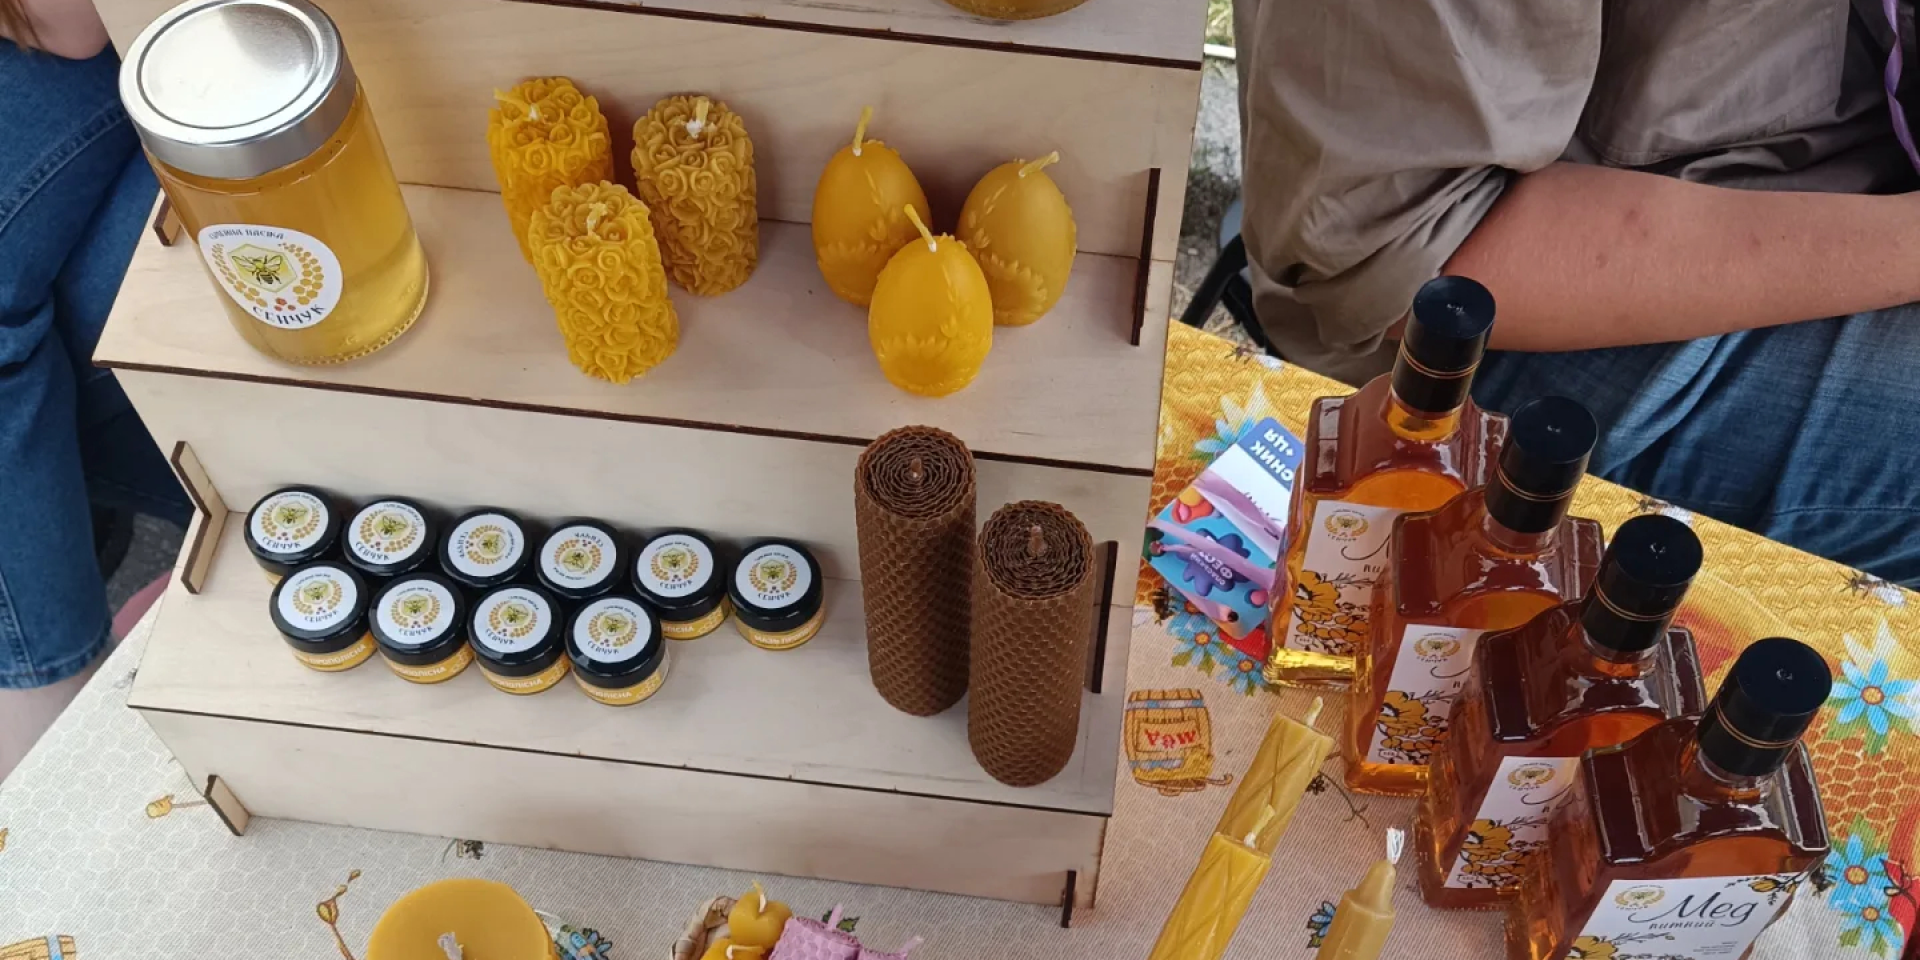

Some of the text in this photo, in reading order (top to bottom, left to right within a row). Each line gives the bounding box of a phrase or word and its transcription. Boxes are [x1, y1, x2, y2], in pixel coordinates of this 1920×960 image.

[252, 304, 325, 325] СЕНЧУК
[1249, 440, 1293, 481] СНИК
[1200, 552, 1233, 579] ФЕС
[1628, 892, 1759, 927] Мед
[1649, 920, 1715, 930] питний
